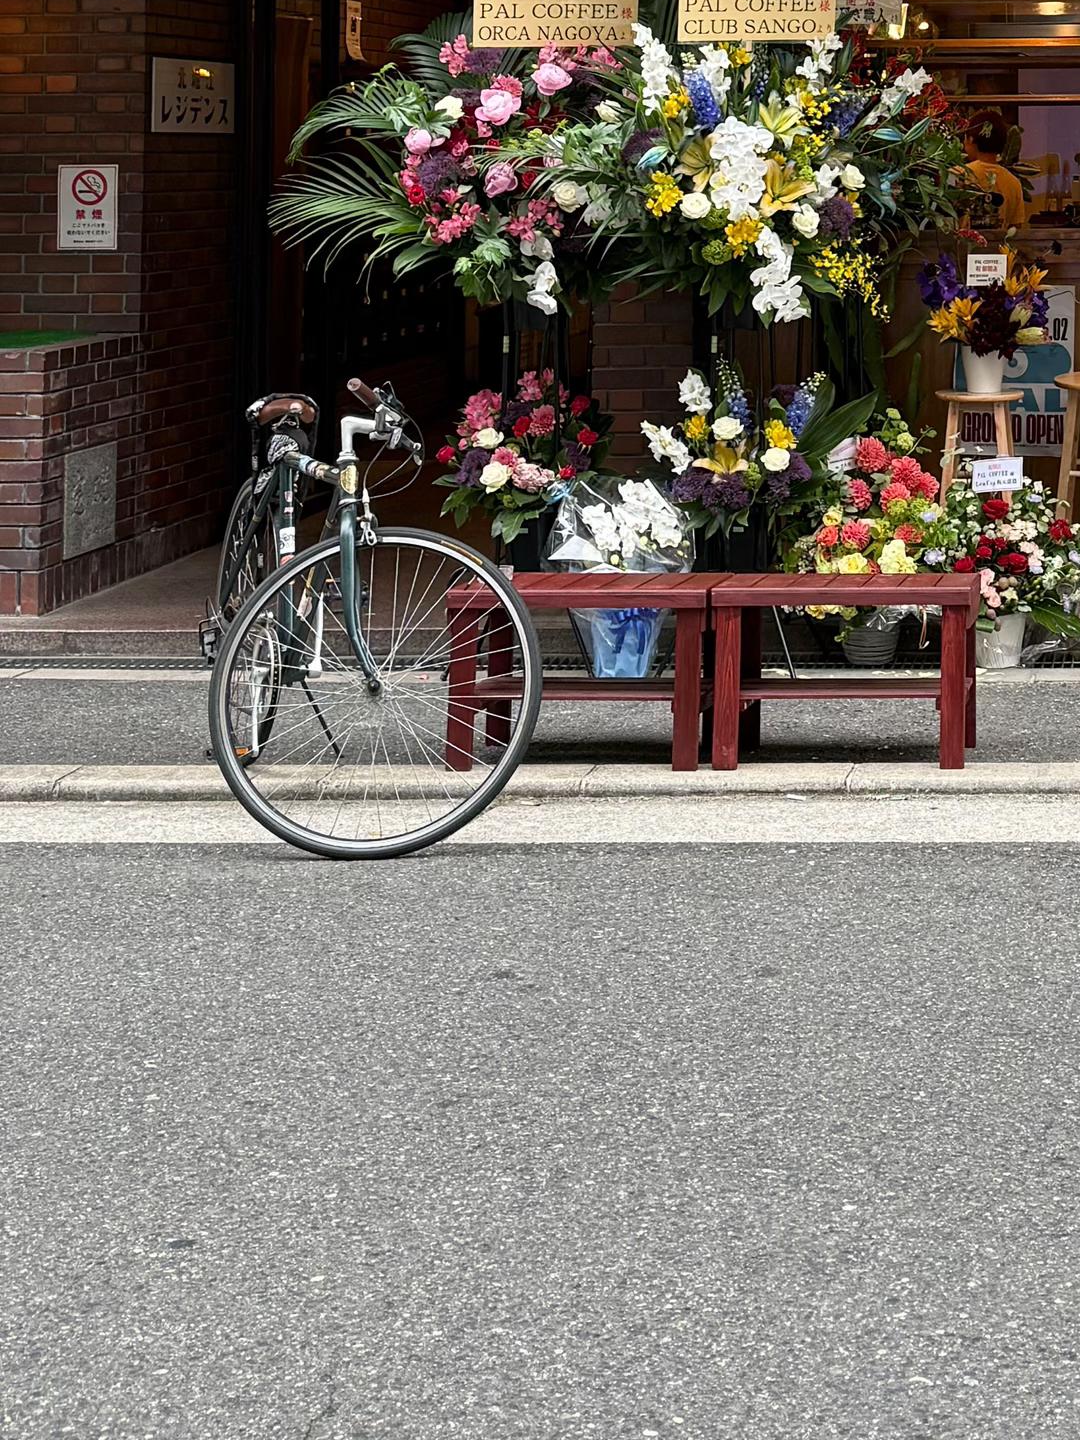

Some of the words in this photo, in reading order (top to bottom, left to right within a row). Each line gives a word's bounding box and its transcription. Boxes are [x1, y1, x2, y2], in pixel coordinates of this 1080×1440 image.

[479, 3, 524, 19] PAL
[532, 3, 619, 19] COFFEE
[478, 25, 530, 40] ORCA
[537, 25, 618, 41] NAGOYA
[684, 19, 738, 35] CLUB
[744, 19, 816, 34] SANGO
[161, 95, 229, 124] レジデンス
[76, 209, 103, 220] 禁煙
[961, 412, 1022, 443] GROD
[1026, 414, 1064, 445] OPEN
